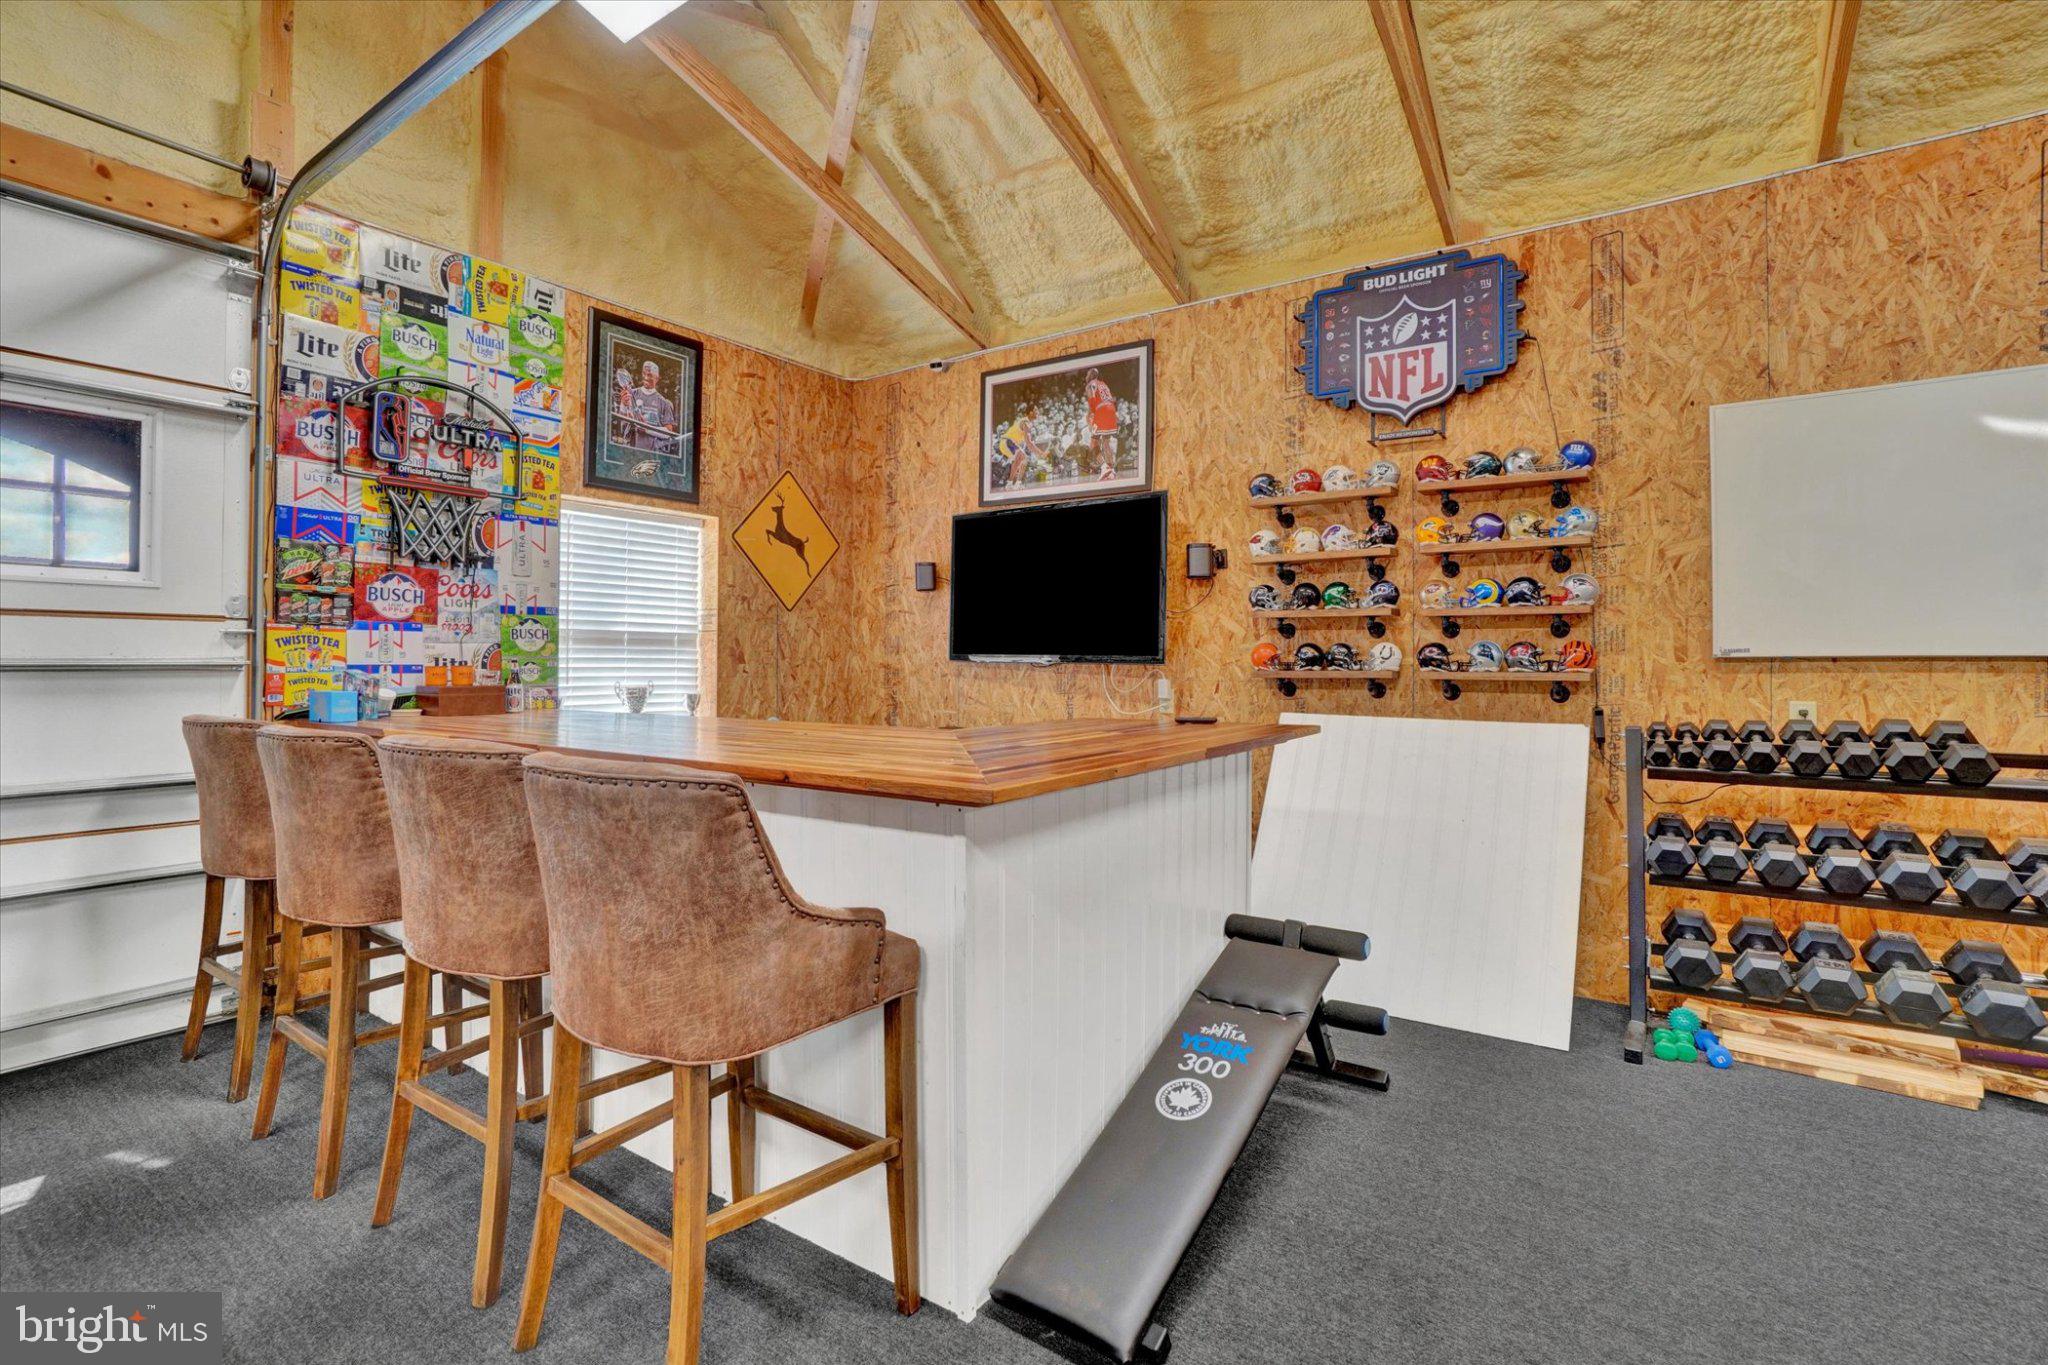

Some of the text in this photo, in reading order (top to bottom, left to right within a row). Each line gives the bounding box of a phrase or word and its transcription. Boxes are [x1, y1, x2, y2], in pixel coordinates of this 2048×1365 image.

[334, 231, 352, 247] TEA
[384, 247, 421, 273] Lite
[1363, 264, 1447, 291] BUD LIGHT
[290, 280, 353, 304] TWISTED TEA
[475, 265, 487, 313] TWISTED TEA
[534, 289, 554, 314] Lit
[392, 329, 438, 351] BUSCH
[466, 328, 505, 351] Natural
[519, 320, 557, 340] BUSCH
[297, 332, 339, 358] Lite
[1368, 347, 1444, 402] NFL
[297, 420, 359, 445] BUSH
[433, 425, 502, 450] ULTRA
[398, 464, 470, 483] Official Beer Sponsor
[541, 457, 555, 471] TEA
[304, 473, 340, 485] ULTRA
[368, 586, 423, 604] BUSCH
[437, 575, 493, 599] Coors
[382, 605, 410, 614] APPLE
[443, 599, 479, 608] LIGHT
[275, 635, 340, 649] TWISTED TEA
[511, 629, 549, 640] BUSCH
[288, 677, 328, 686] TWISTED TEA
[519, 667, 542, 675] BUSCH
[1181, 1032, 1254, 1065] YORK
[1178, 1053, 1232, 1079] 300
